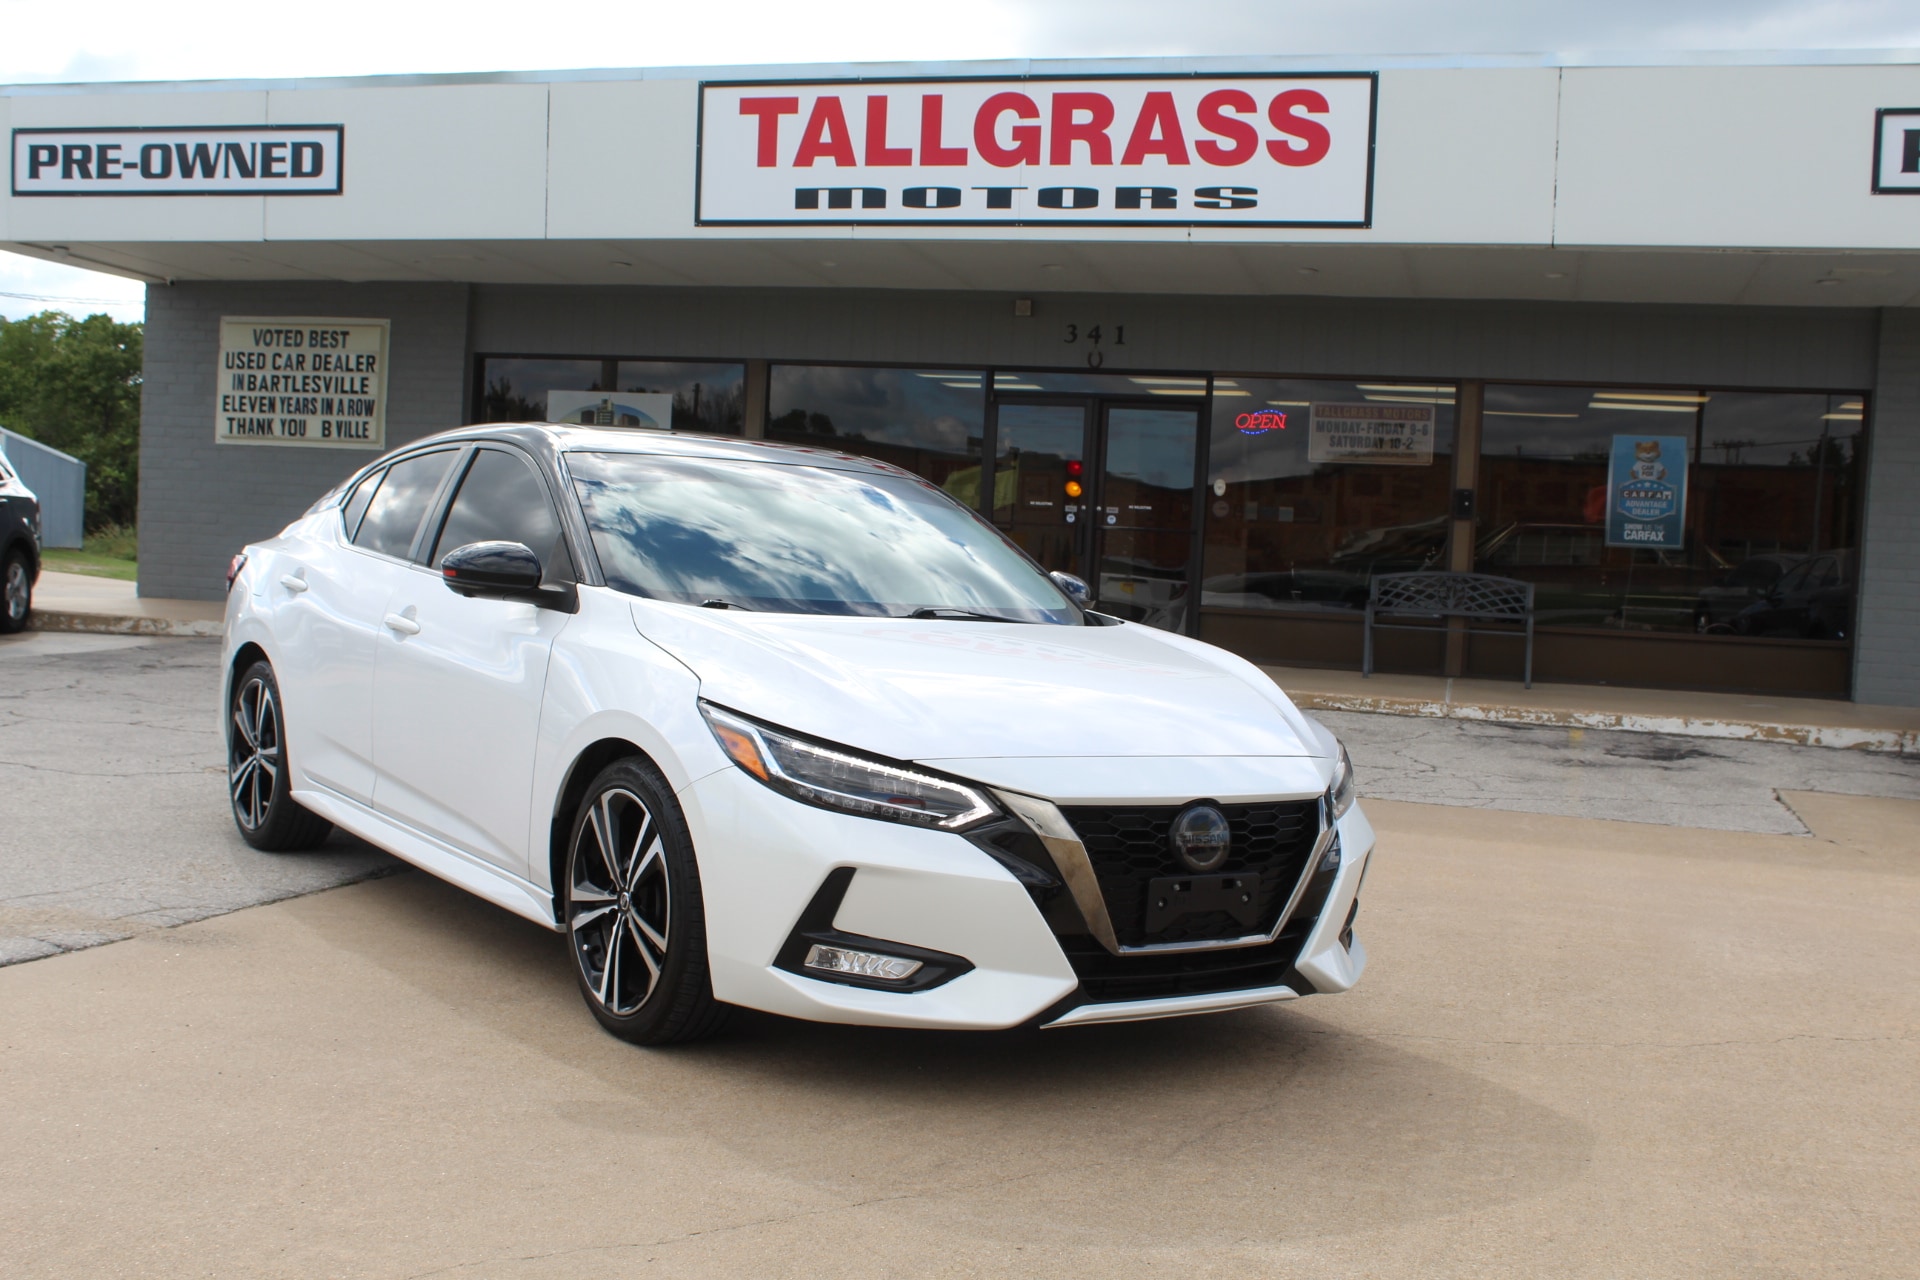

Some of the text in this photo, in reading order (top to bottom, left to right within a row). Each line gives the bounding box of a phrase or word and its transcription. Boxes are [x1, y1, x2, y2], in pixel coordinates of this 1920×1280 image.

[739, 88, 1332, 169] TALLGRASS
[28, 141, 324, 180] PRE-OWNED
[795, 186, 1258, 210] MOTORS
[253, 328, 350, 348] VOTED BEST
[1063, 324, 1126, 345] 341
[225, 351, 376, 373] USED CAR DEALER
[232, 373, 369, 394] IN BARTLESVILLE
[222, 395, 375, 417] ELEVEN YEARS IN A ROW
[1317, 406, 1430, 420] TALLGRASS MOTORS
[226, 417, 369, 439] THANK YOU B VILLE
[1235, 413, 1287, 430] OPEN
[1316, 420, 1406, 435] MONDAY-FRIDAY
[1329, 435, 1385, 449] SATURDAY
[1625, 500, 1668, 508] ADVANTAGE
[1632, 508, 1660, 516] DEALER
[1624, 530, 1664, 541] CARFAX
